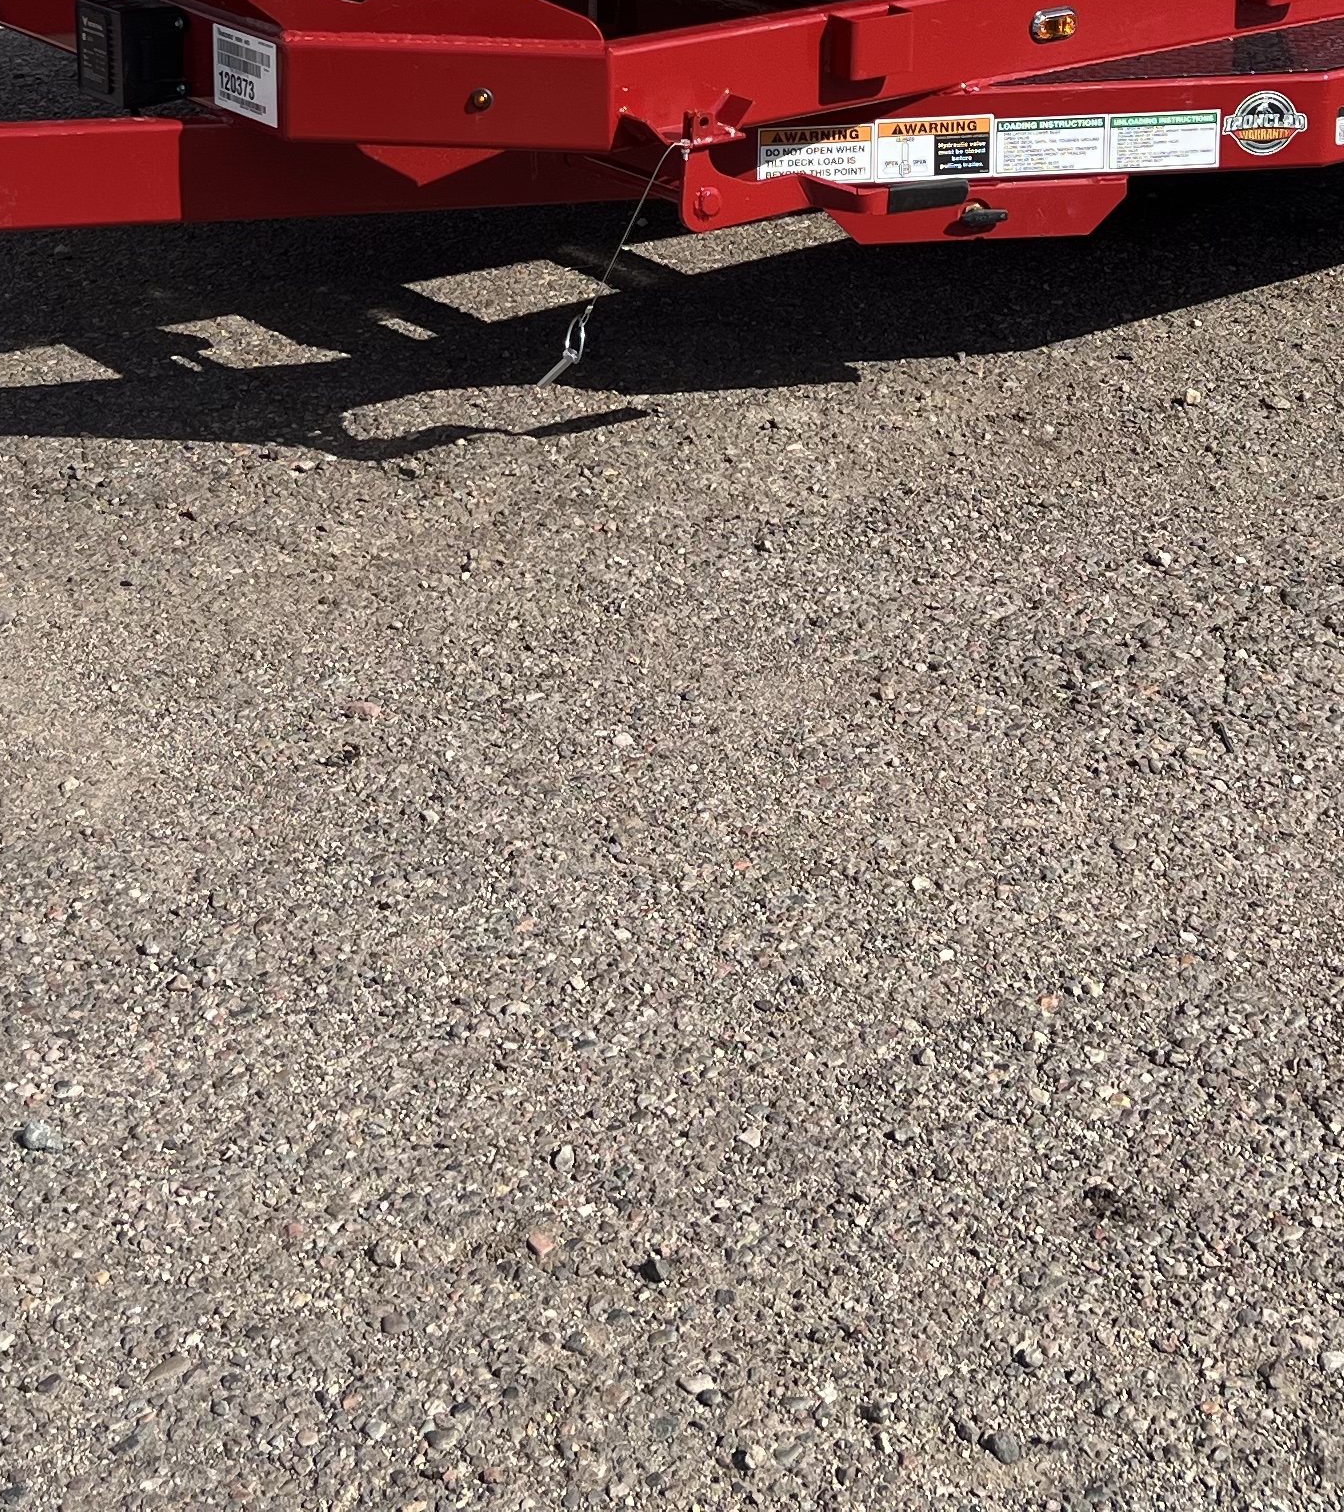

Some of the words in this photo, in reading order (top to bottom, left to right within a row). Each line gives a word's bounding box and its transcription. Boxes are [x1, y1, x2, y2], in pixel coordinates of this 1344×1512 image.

[218, 69, 256, 101] 120373
[998, 121, 1038, 131] LOADING
[1039, 118, 1104, 129] INSTRUCTIONS
[1158, 114, 1215, 125] INSTRUCTIONS
[1225, 113, 1305, 132] IRONCLAD
[903, 120, 978, 135] WARNING
[784, 128, 860, 143] WARNING
[1239, 128, 1291, 141] WARRANTY
[765, 148, 781, 157] DO
[782, 148, 802, 156] NOT
[805, 146, 833, 155] OPEN
[835, 145, 866, 153] WHEN
[765, 160, 785, 168] TILT
[787, 158, 815, 167] DECK
[817, 157, 845, 166] LOAD
[846, 156, 856, 164] IS
[809, 168, 832, 177] THIS
